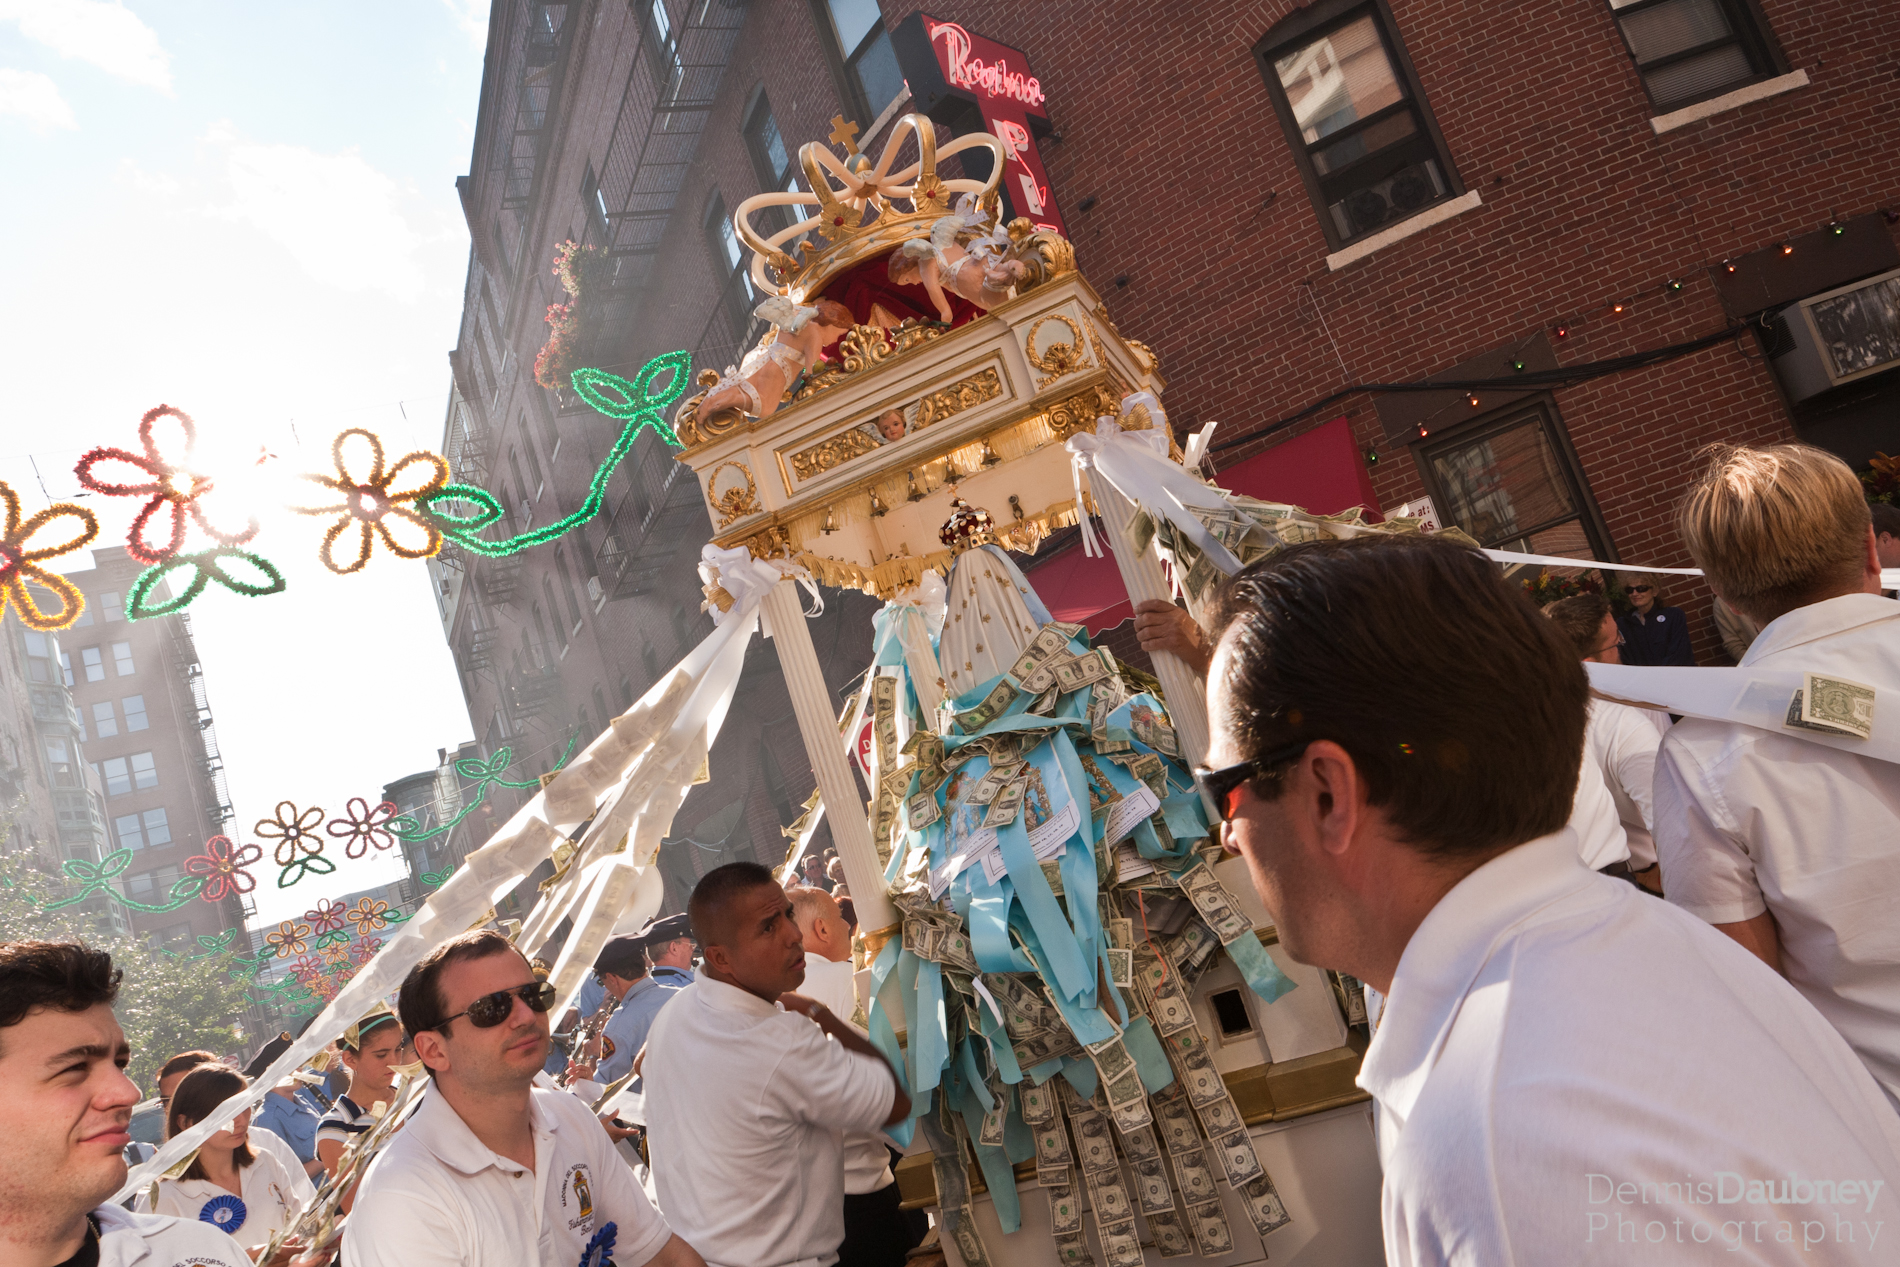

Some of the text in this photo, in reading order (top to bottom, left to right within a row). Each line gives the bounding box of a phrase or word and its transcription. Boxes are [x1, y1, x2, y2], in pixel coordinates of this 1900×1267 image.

[929, 22, 1045, 107] Regina
[1417, 505, 1430, 517] at:
[185, 1257, 226, 1267] SOCCORSO
